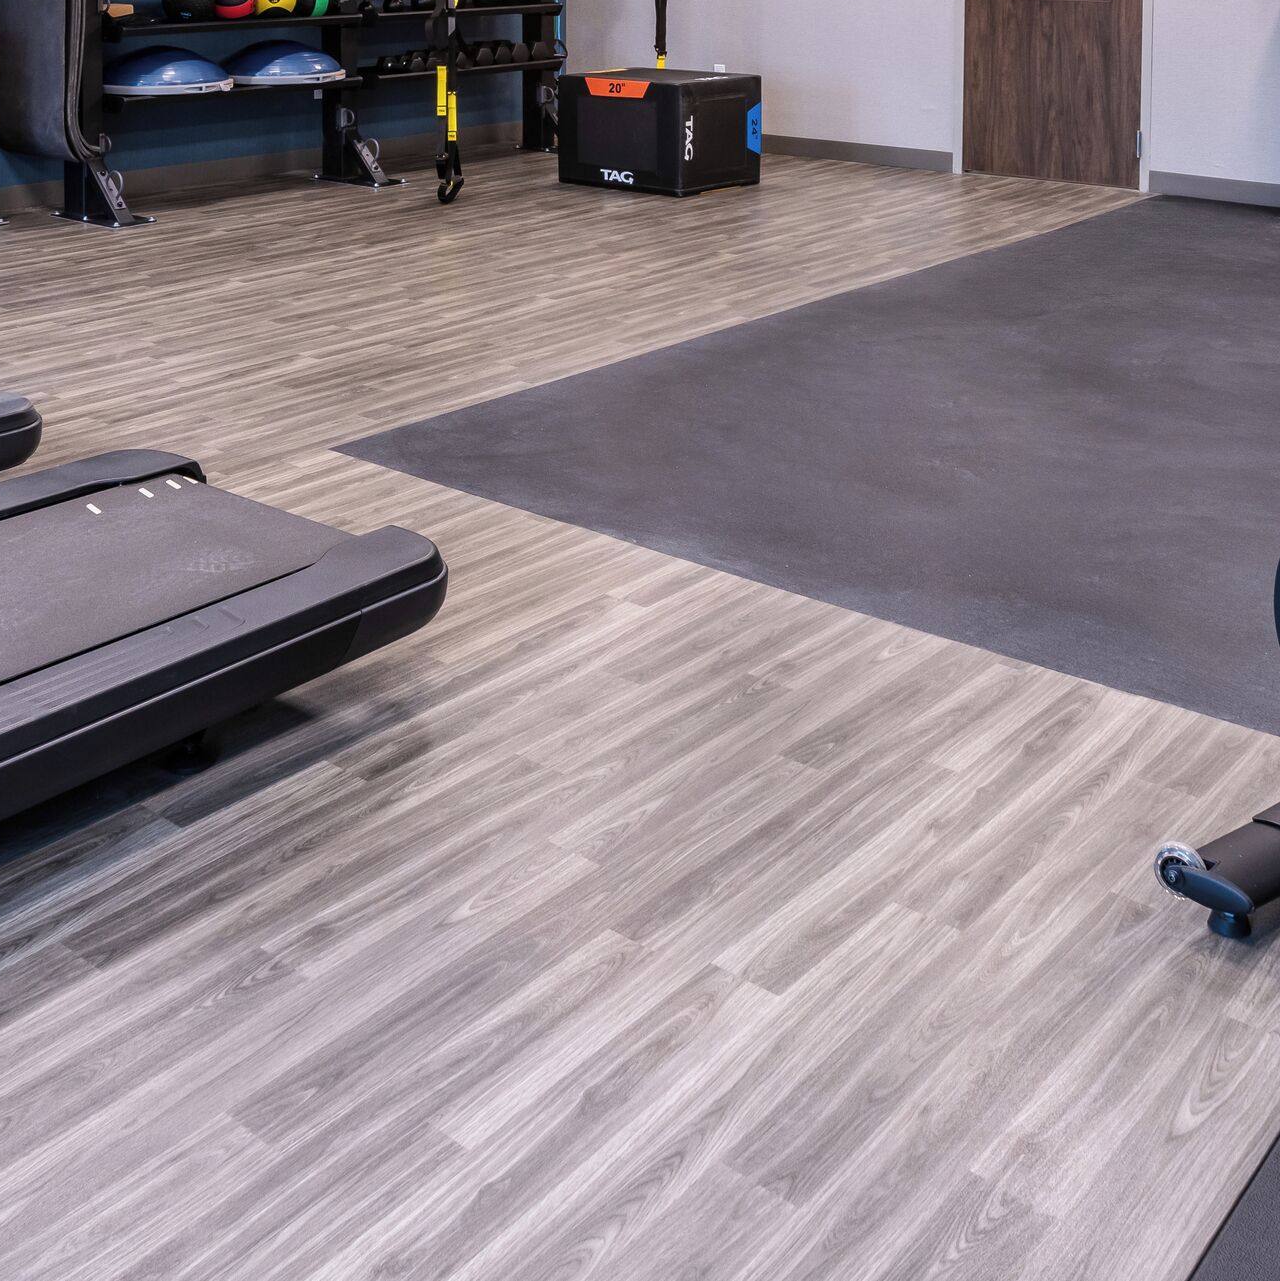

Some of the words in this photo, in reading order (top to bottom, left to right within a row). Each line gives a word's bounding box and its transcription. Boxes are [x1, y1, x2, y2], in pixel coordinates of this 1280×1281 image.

[608, 82, 626, 94] 20"
[683, 114, 694, 161] TAG
[599, 168, 634, 185] TAG
